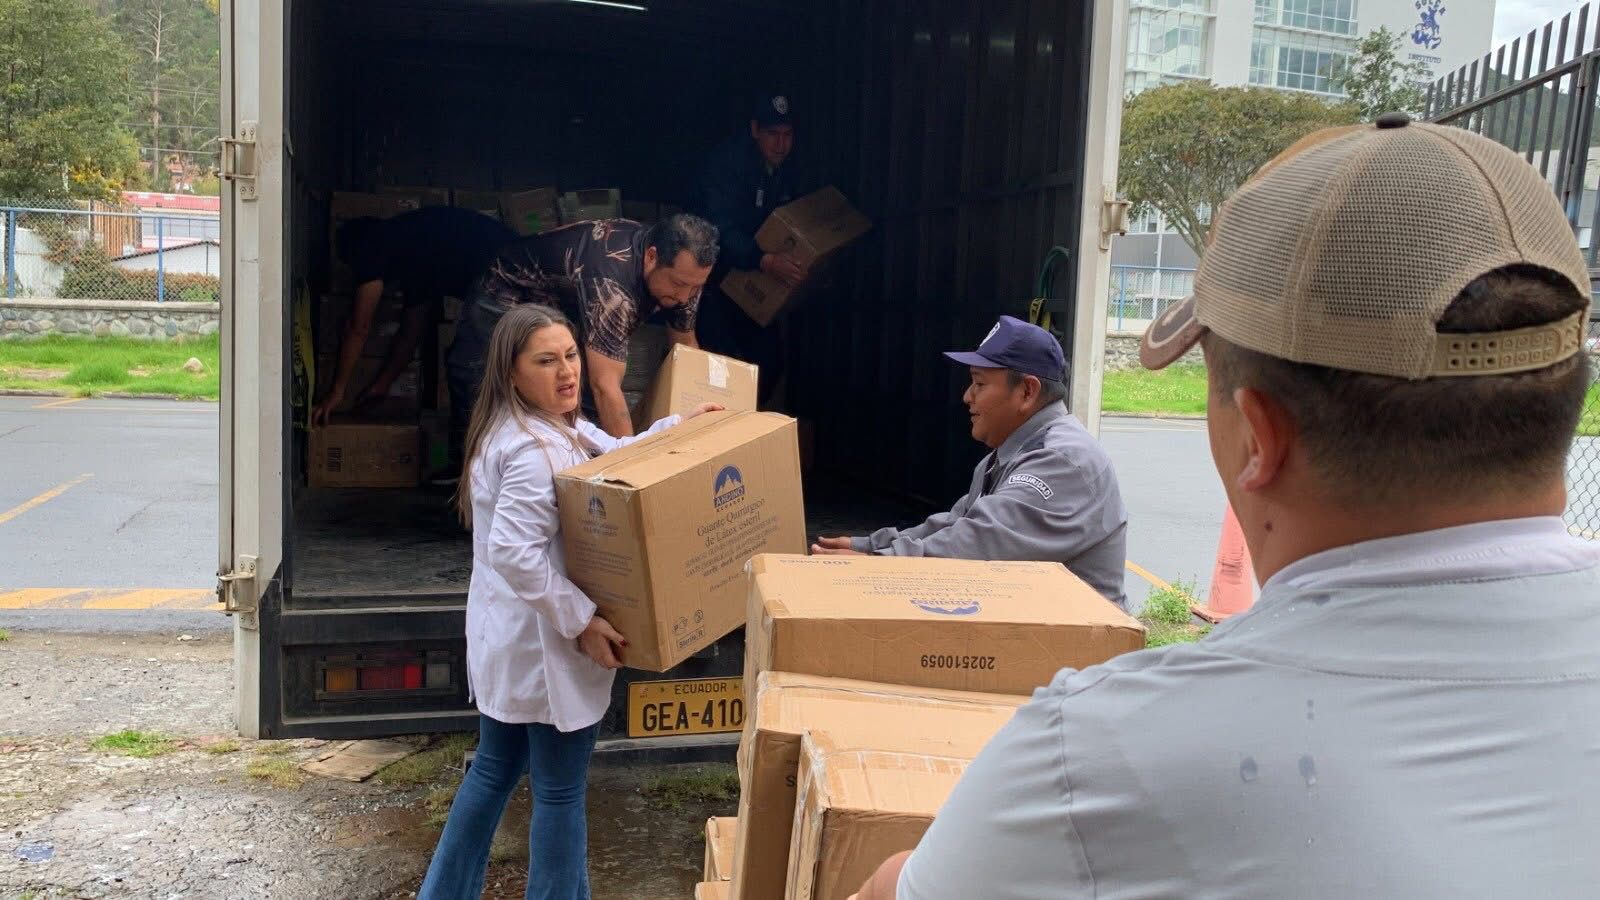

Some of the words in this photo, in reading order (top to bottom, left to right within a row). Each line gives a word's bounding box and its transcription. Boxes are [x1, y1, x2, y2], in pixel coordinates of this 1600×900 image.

[1408, 53, 1441, 63] INSTITUTO
[1011, 475, 1051, 496] SEGURIDAD
[716, 496, 744, 512] ECUADOR
[697, 518, 725, 537] Guante
[705, 536, 715, 548] de
[920, 654, 996, 670] 202510059
[674, 682, 728, 695] ECUADOR
[642, 698, 747, 732] GEA-410
